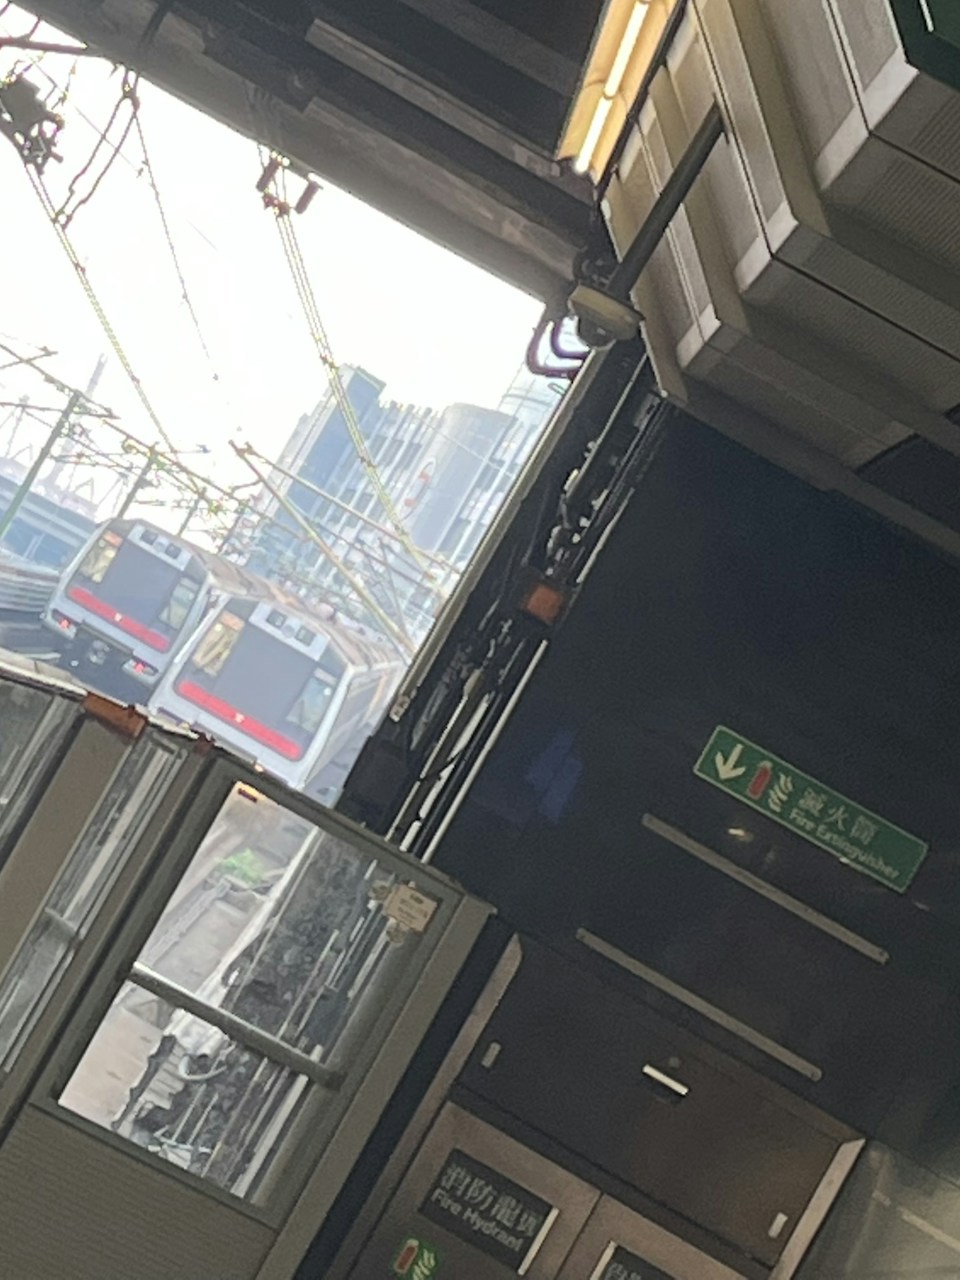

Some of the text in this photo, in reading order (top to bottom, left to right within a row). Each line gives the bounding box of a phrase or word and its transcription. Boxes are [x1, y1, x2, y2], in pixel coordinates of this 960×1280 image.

[790, 807, 899, 878] Fire Extinguisher
[430, 1187, 524, 1252] Fire Hydrant
